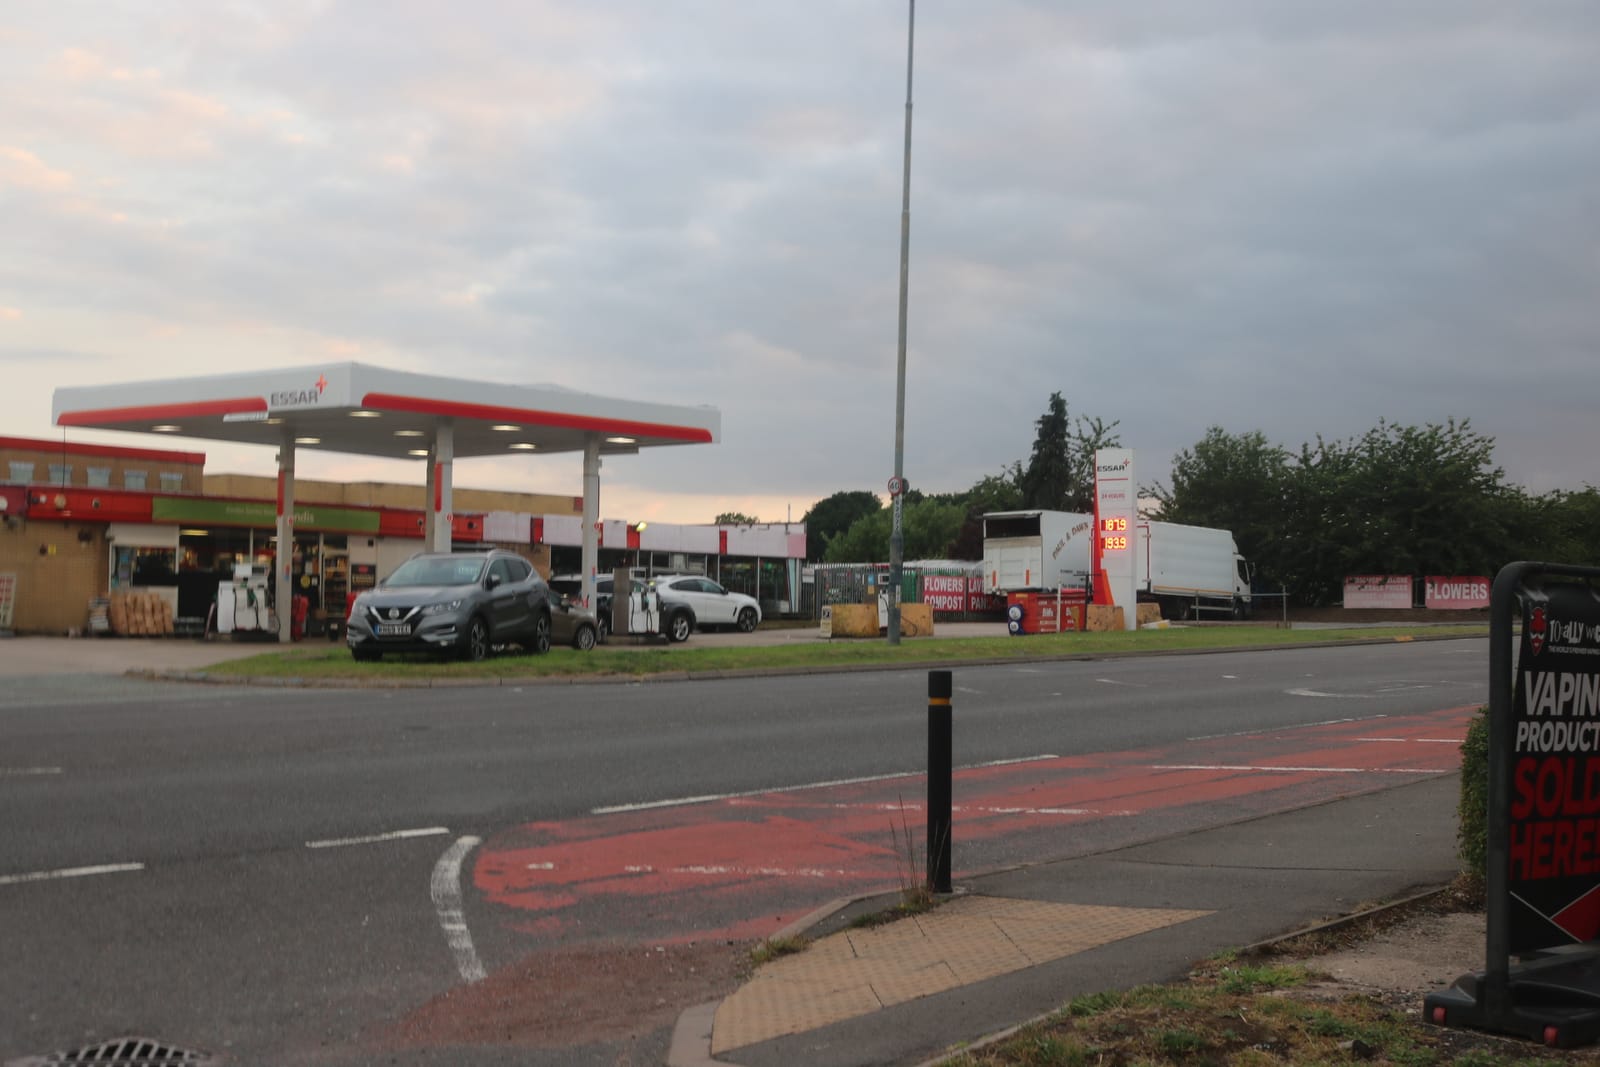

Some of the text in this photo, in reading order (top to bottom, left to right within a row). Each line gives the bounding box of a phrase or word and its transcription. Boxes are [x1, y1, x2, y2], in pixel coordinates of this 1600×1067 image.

[270, 390, 319, 406] ESSAR
[1097, 464, 1125, 472] ESSAR
[923, 577, 964, 592] FLOWERS
[1426, 584, 1488, 600] FLOWERS
[923, 595, 963, 609] COMPOST
[1524, 670, 1600, 716] VAPIN
[1512, 756, 1600, 819] SOLD
